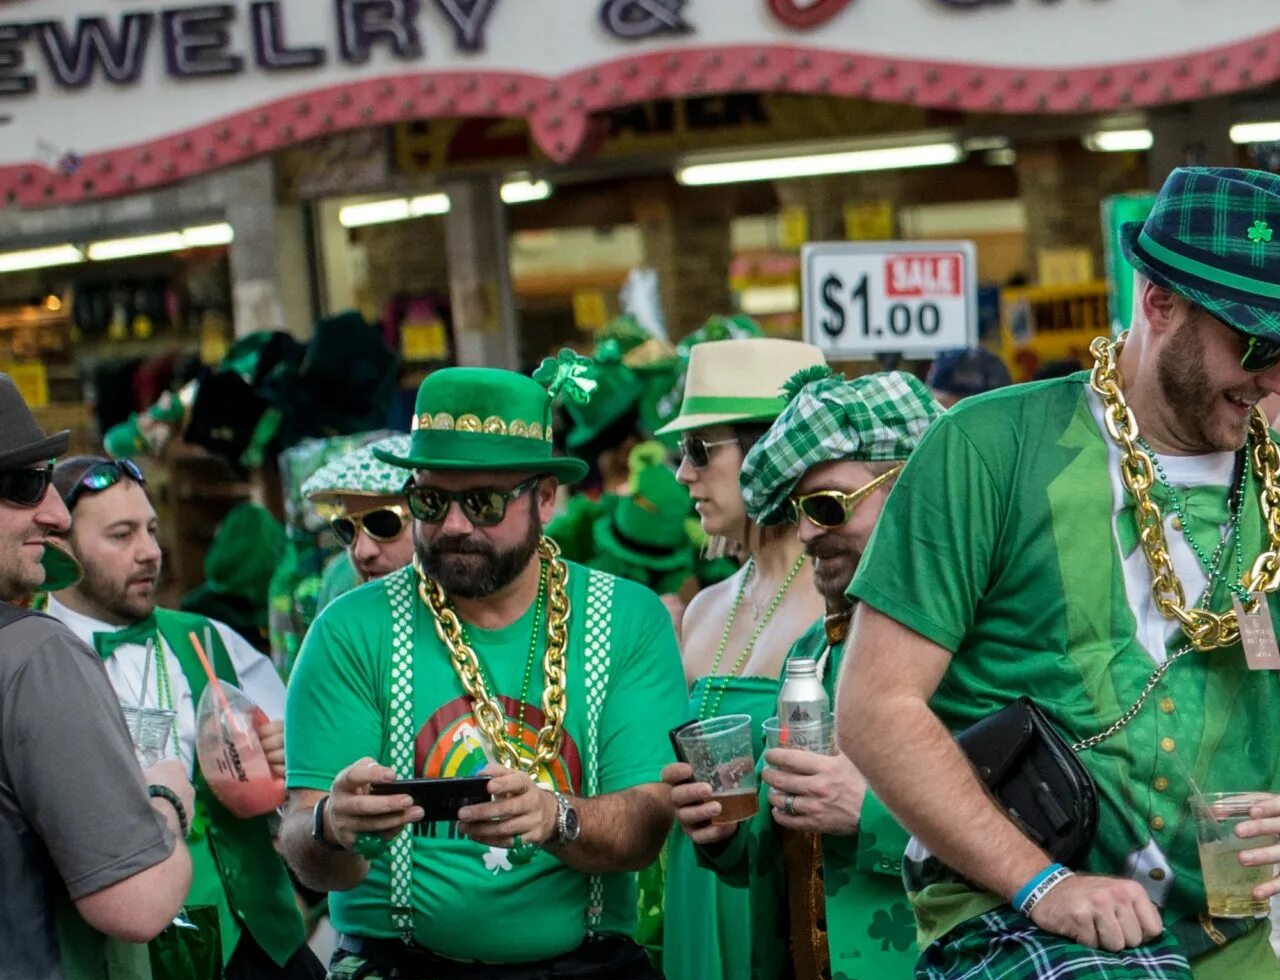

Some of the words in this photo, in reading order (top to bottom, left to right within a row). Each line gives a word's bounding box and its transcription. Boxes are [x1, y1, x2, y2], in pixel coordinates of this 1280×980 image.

[892, 257, 953, 291] SALE
[821, 271, 941, 339] $1.00
[1037, 873, 1059, 894] DOING
